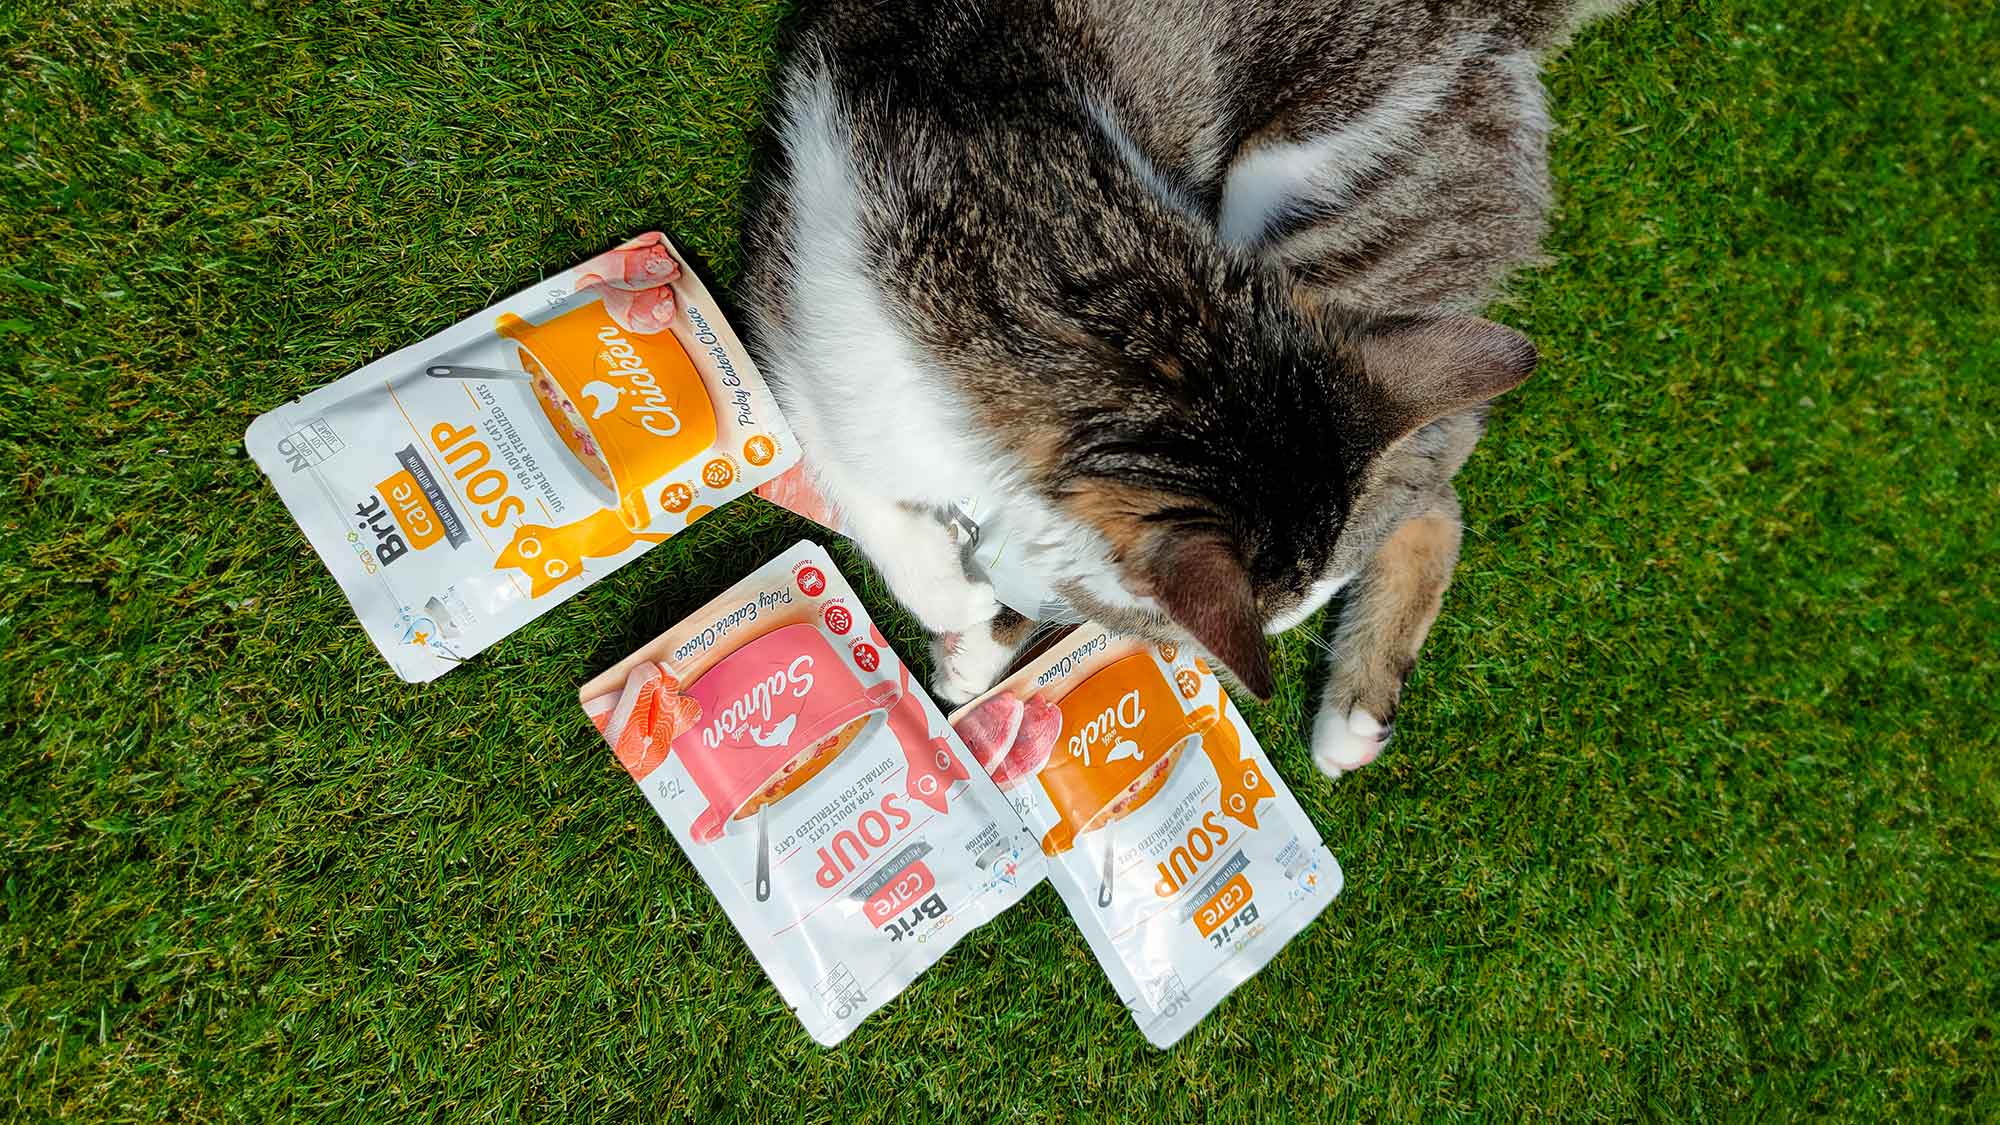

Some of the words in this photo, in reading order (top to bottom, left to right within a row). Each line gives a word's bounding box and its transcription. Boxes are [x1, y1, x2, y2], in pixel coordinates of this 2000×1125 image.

[685, 305, 717, 344] Choice
[475, 382, 496, 407] CATS
[596, 323, 681, 437] Chicken
[732, 391, 755, 426] Picky
[481, 417, 504, 442] CATS
[489, 404, 527, 455] STERILIZED
[276, 437, 309, 473] NO
[405, 455, 433, 489] NUTRITION
[496, 439, 523, 473] ADULT
[520, 452, 539, 473] FOR
[428, 421, 525, 528] SOUP
[515, 470, 535, 491] FOR
[390, 481, 433, 536] care
[426, 487, 439, 500] BY
[532, 470, 566, 514] SUITABLE
[354, 493, 408, 568] Brit
[433, 498, 462, 537] PREVENTION
[758, 586, 793, 609] Picky
[674, 629, 715, 662] Choice
[1036, 656, 1070, 687] Choice
[703, 654, 815, 749] Salmon
[1067, 688, 1144, 765] Duck
[1100, 728, 1117, 745] with
[658, 777, 685, 799] 75g
[855, 756, 894, 791] SUITABLE
[838, 785, 857, 804] FOR
[855, 786, 875, 806] FOR
[794, 798, 840, 838] STERILIZED
[828, 800, 858, 827] ADULT
[773, 833, 795, 855] CATS
[807, 821, 830, 844] CATS
[815, 792, 910, 888] SOUP
[964, 820, 997, 852] HYDRATION
[1154, 810, 1228, 897] SOUP
[874, 872, 923, 916] care
[1201, 884, 1243, 926] care
[883, 892, 948, 943] Brit
[1208, 901, 1259, 949] Brit
[833, 989, 867, 1019] NO
[1162, 988, 1192, 1016] NO
